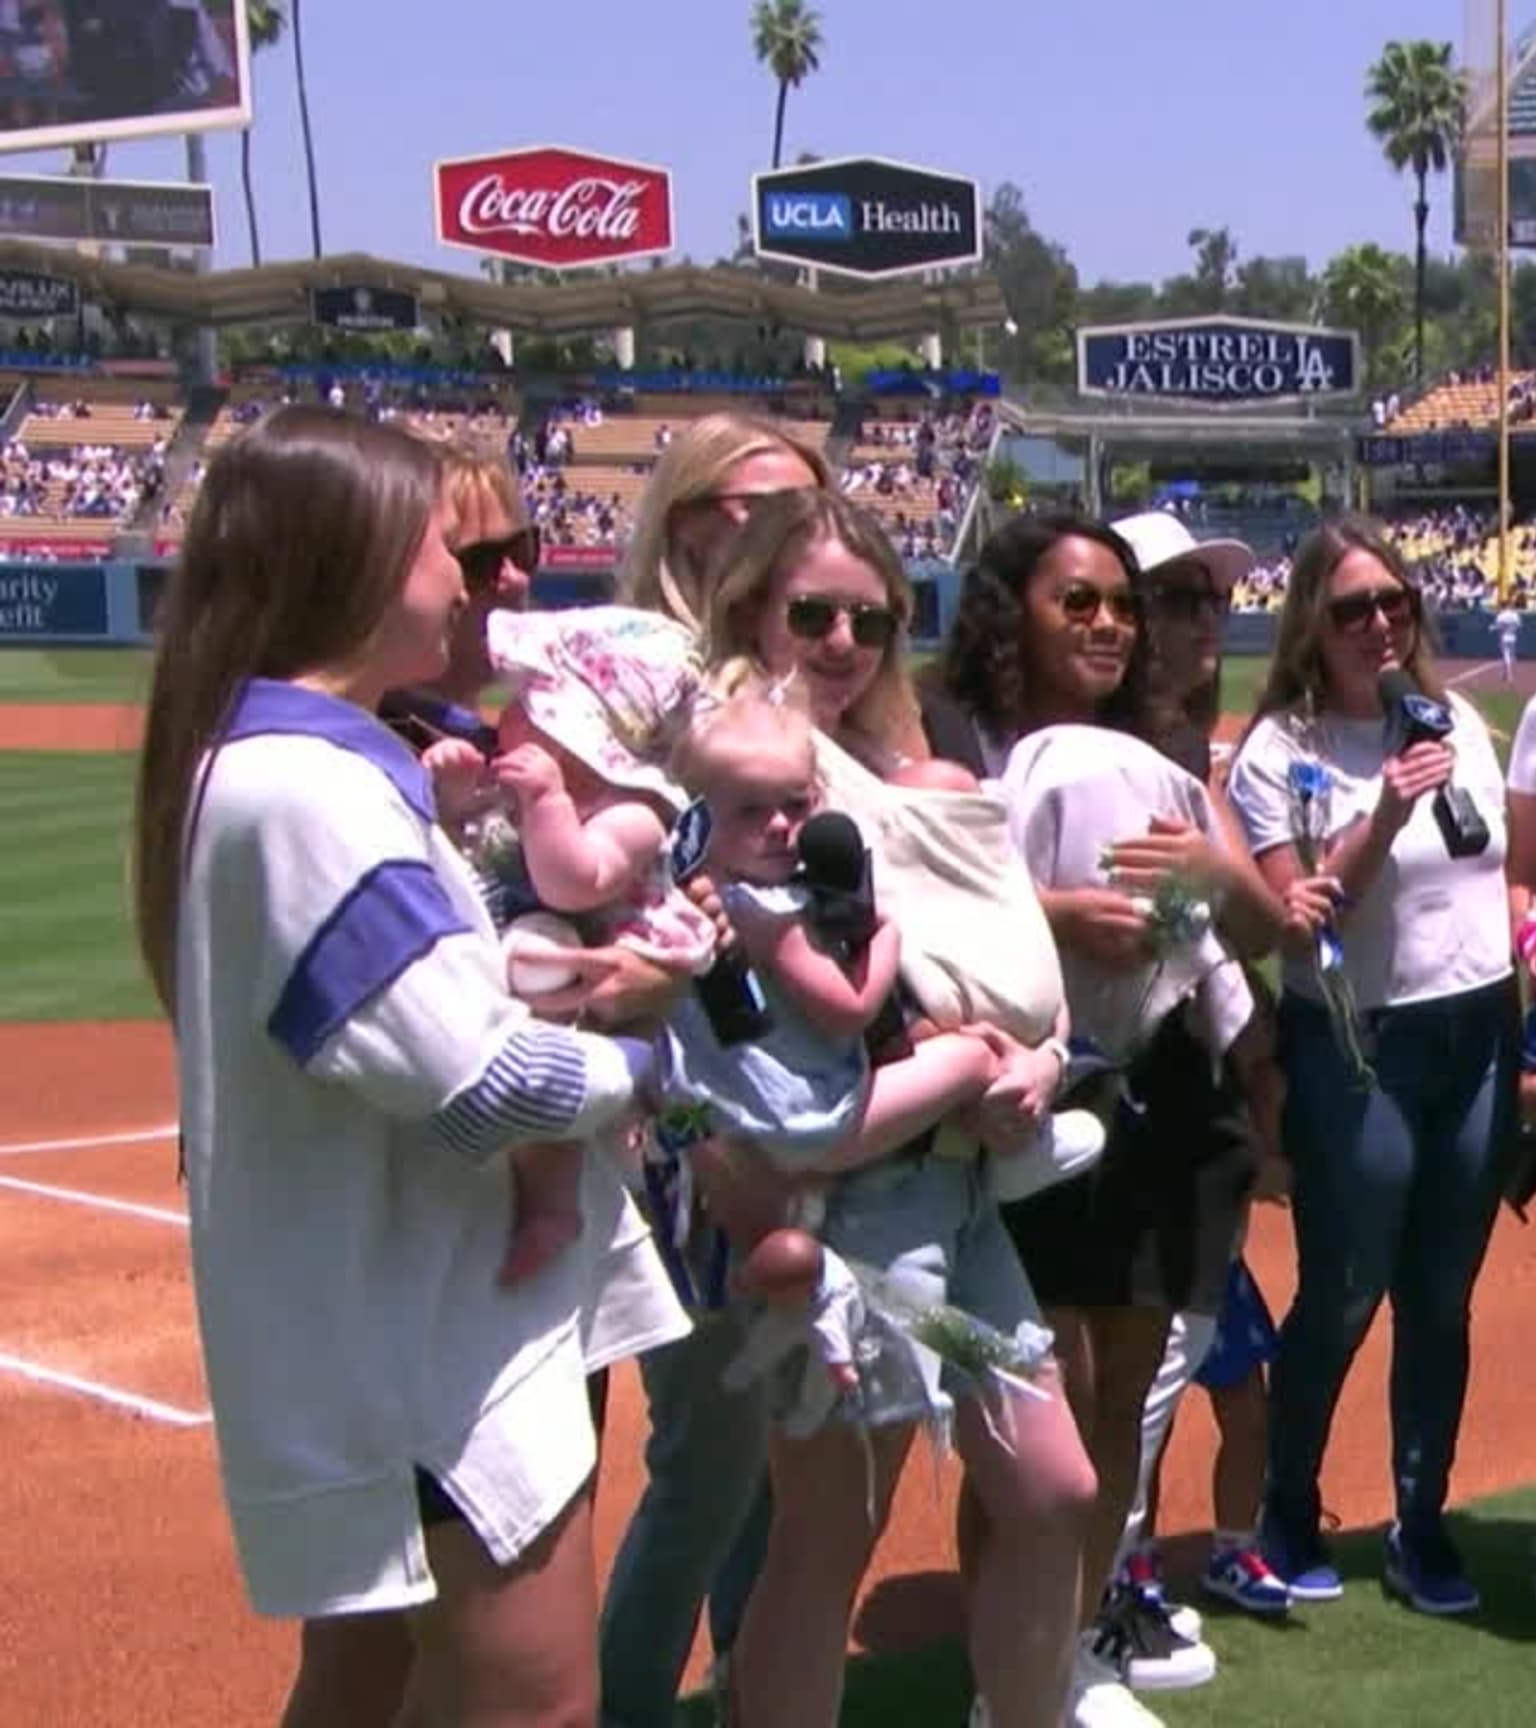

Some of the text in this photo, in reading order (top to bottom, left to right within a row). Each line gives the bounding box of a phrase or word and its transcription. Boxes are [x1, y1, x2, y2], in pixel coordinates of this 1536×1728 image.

[459, 174, 648, 237] Coca-Cola
[771, 201, 960, 233] UCLA Health
[1106, 362, 1284, 391] JALISCO
